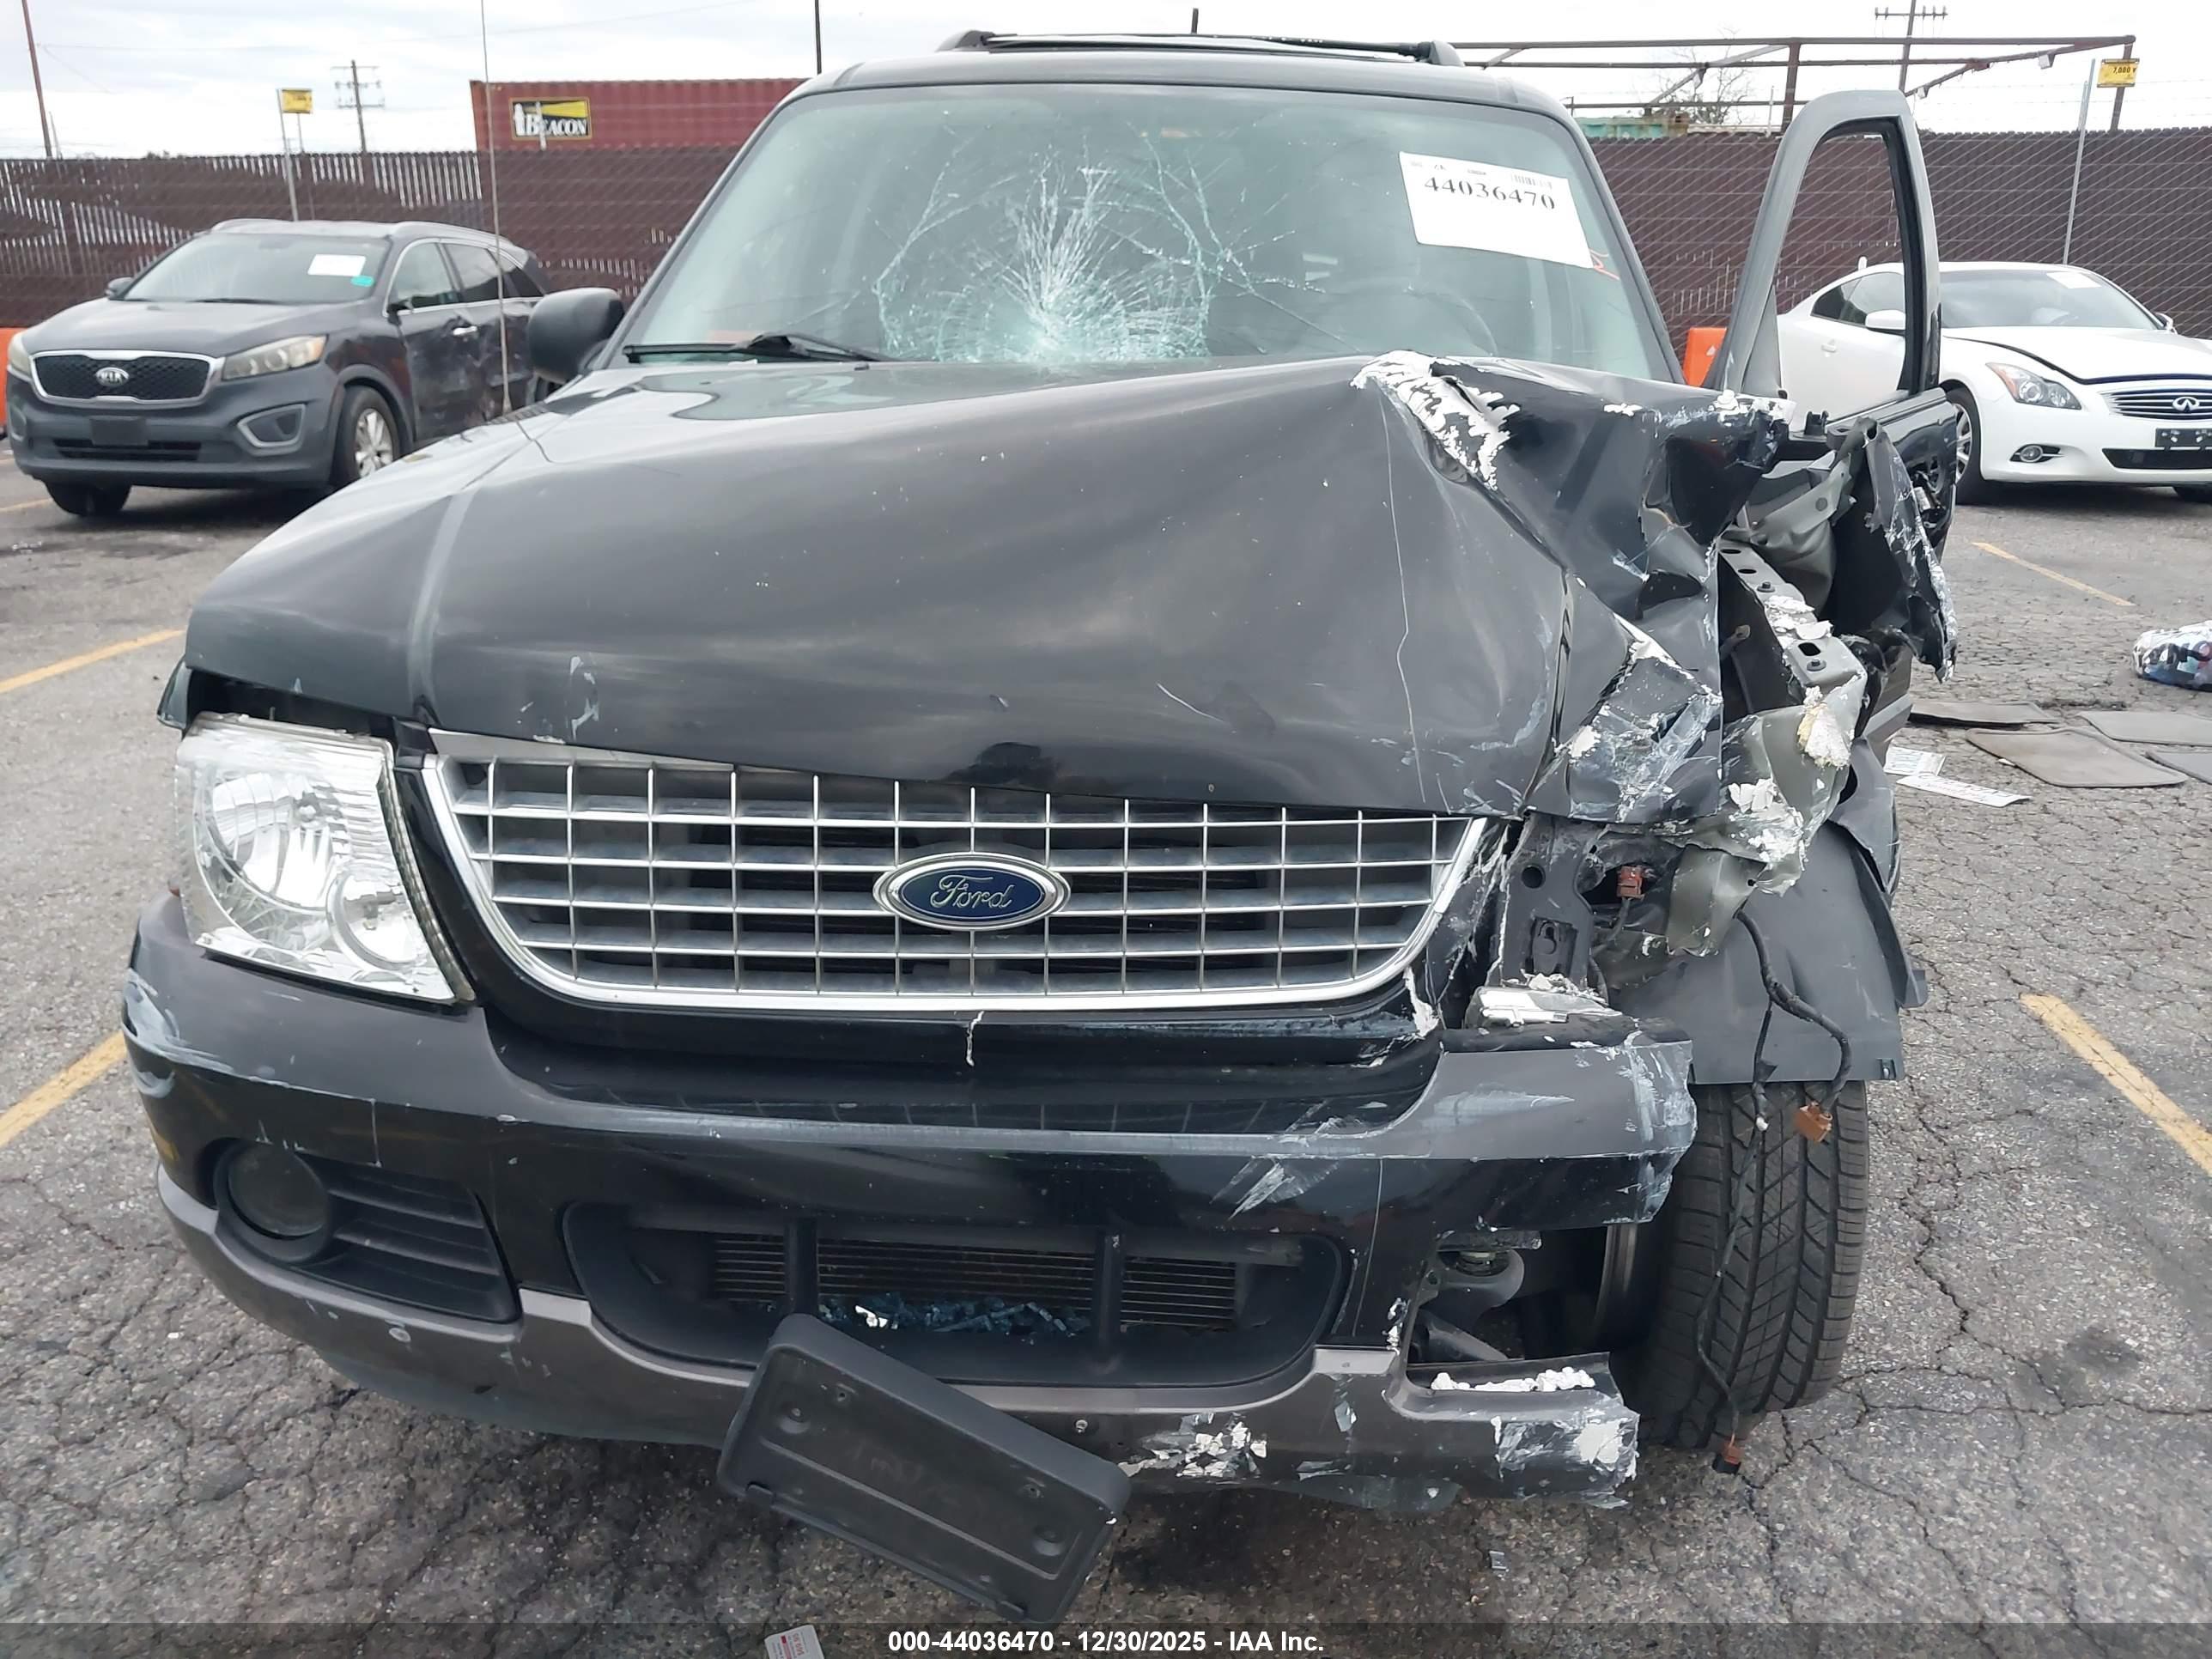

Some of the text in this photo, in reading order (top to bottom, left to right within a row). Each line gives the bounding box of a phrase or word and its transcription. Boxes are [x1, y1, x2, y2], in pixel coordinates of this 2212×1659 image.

[2113, 66, 2131, 75] 7,000
[1424, 176, 1556, 210] 44036470
[929, 873, 1015, 909] Ford
